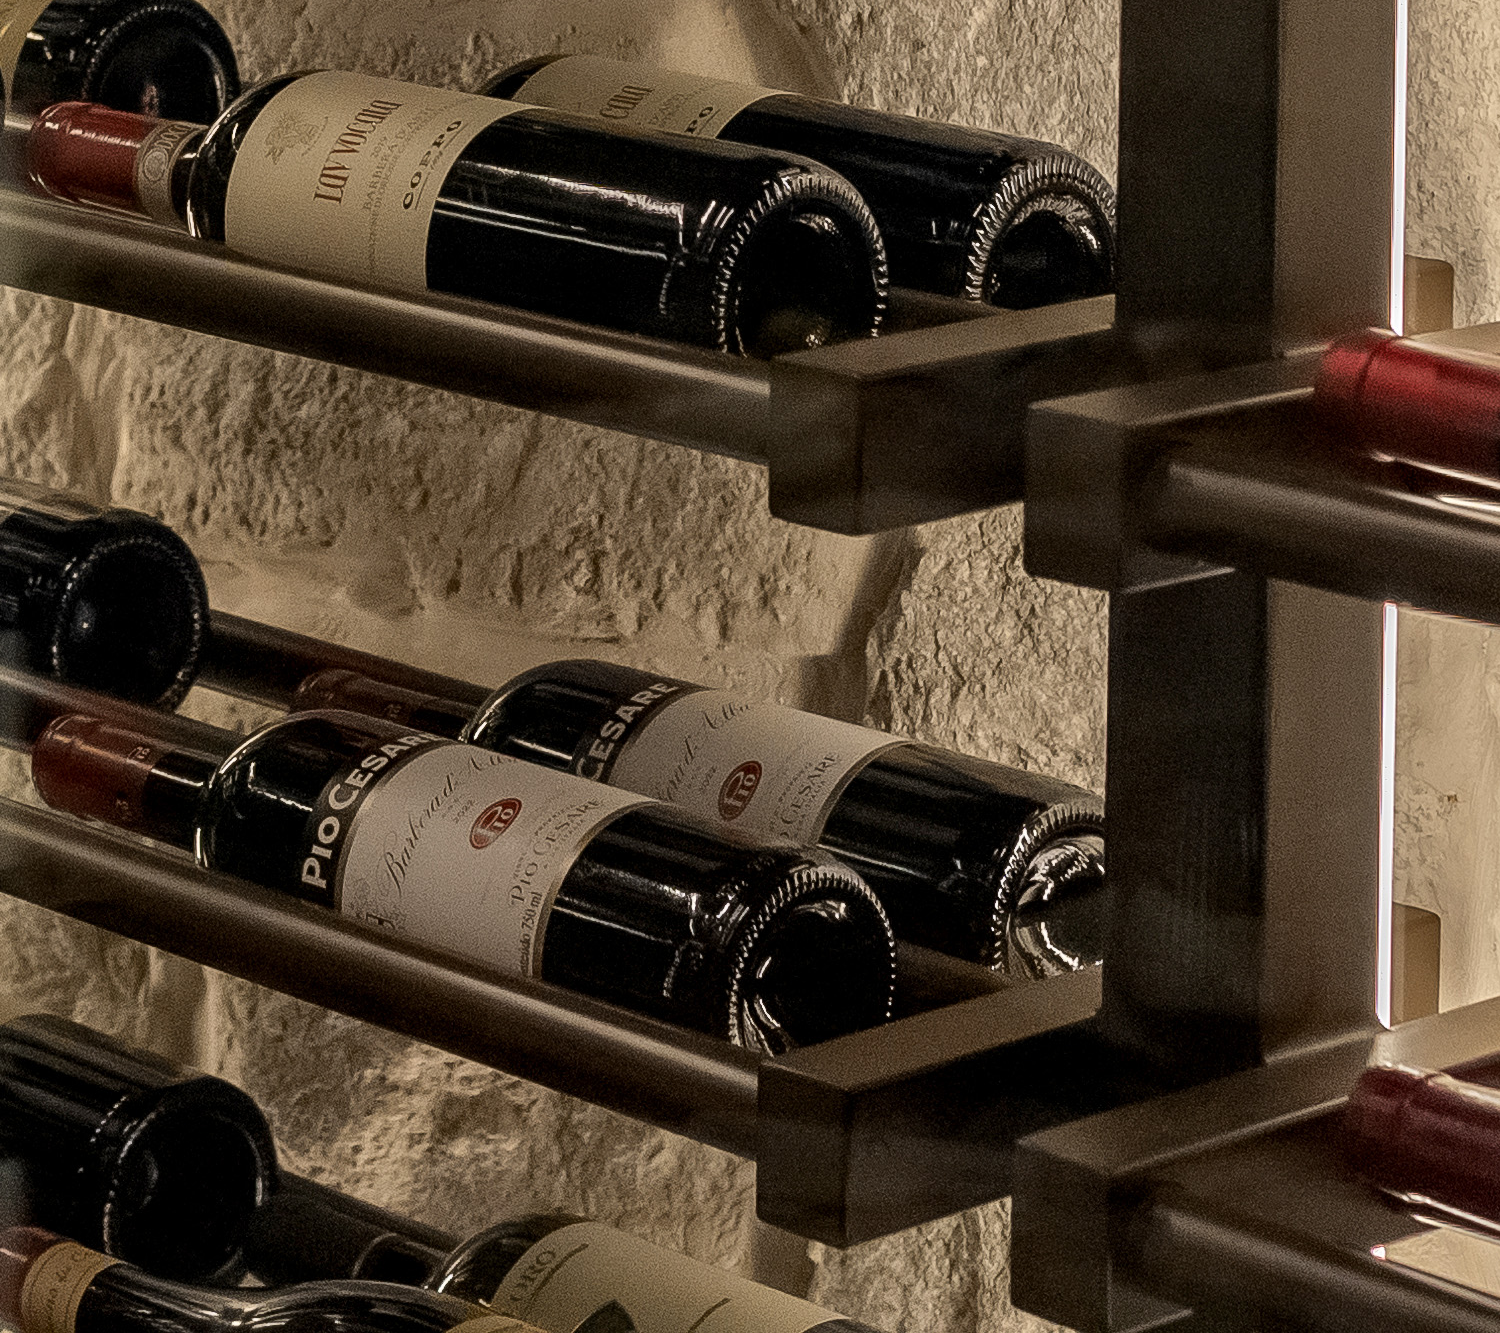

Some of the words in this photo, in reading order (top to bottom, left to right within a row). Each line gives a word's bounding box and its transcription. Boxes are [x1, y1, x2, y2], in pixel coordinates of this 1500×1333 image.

[402, 118, 464, 211] COPPO
[576, 682, 678, 781] CESARE
[780, 753, 838, 826] CESARE
[301, 815, 342, 889] PIO
